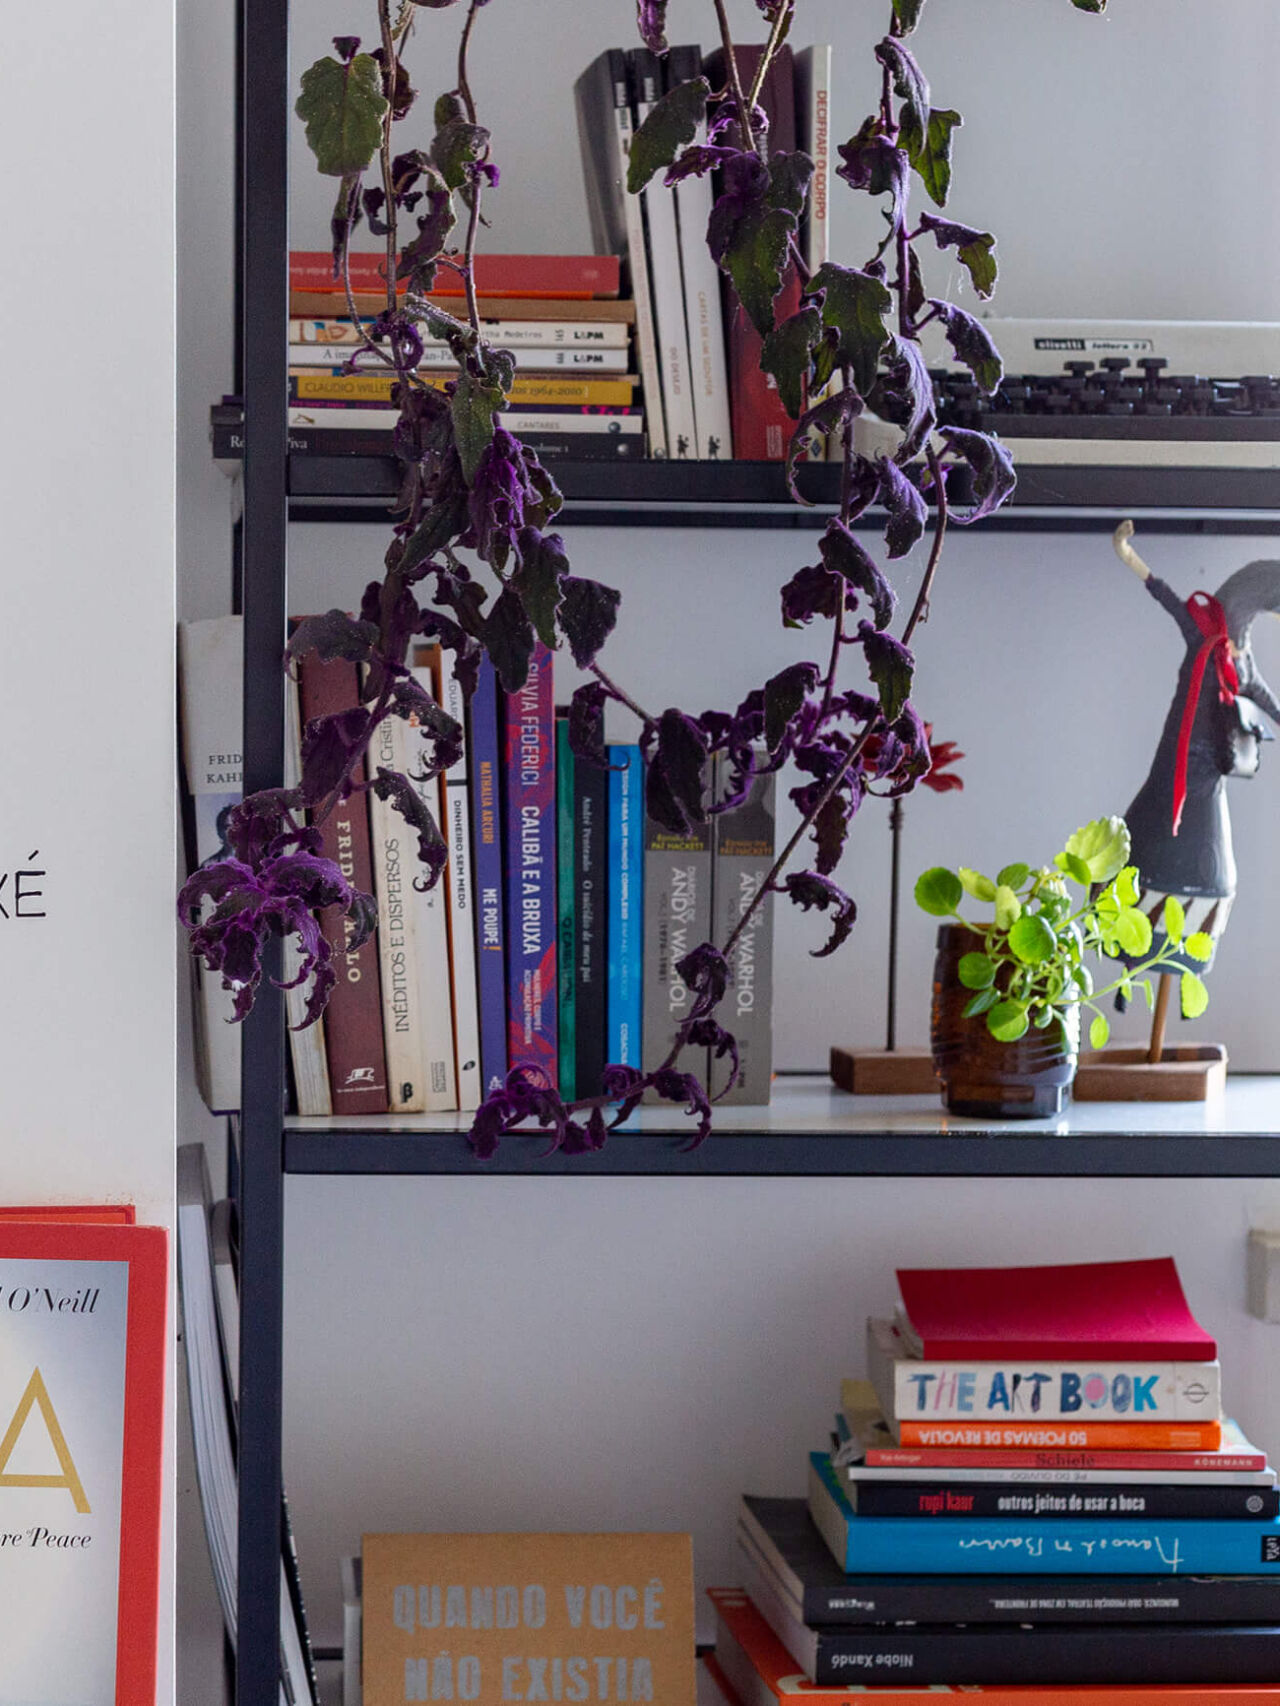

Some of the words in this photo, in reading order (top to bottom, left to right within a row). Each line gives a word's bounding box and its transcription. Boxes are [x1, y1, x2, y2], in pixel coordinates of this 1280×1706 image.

[816, 90, 827, 155] DECIFRAR
[816, 159, 827, 168] O
[815, 173, 826, 220] CORPO
[304, 382, 354, 393] CLAUDIO
[449, 679, 458, 721] EDUARD
[380, 716, 393, 762] Cristin
[521, 716, 539, 786] FEDERICI
[207, 754, 243, 765] FRID
[454, 800, 463, 851] DINHEIRO
[521, 805, 543, 866] CALIBÃ
[336, 820, 355, 887] FRID
[456, 854, 465, 875] SEM
[385, 838, 405, 932] DISPERSOS
[522, 869, 540, 880] E
[522, 882, 540, 895] A
[457, 876, 466, 909] MEDO
[483, 888, 497, 904] ME
[671, 867, 688, 923] ANDY
[522, 899, 541, 955] BRUXA
[391, 936, 405, 947] E
[669, 928, 688, 1012] WAHOL
[737, 933, 755, 1017] WARHOL
[389, 950, 410, 1033] INÉDITOS
[8, 1286, 101, 1314] O'Neill
[907, 1371, 977, 1412] THE
[987, 1371, 1053, 1413] ART
[1060, 1371, 1160, 1413] BOOK
[919, 1430, 981, 1445] REVOLTA
[984, 1430, 1001, 1445] DE
[1004, 1430, 1066, 1446] POEMAS
[1068, 1431, 1087, 1446] 50
[1036, 1452, 1095, 1467] Schiele
[918, 1491, 944, 1515] rupi
[946, 1490, 975, 1511] kaur
[997, 1495, 1033, 1511] outros
[1033, 1493, 1067, 1514] jeitos
[1068, 1494, 1083, 1511] de
[1084, 1497, 1108, 1511] usar
[1110, 1498, 1118, 1511] a
[1119, 1494, 1146, 1511] boca
[29, 1527, 92, 1548] Peace
[393, 1584, 547, 1635] QUANDO
[564, 1577, 666, 1631] VOCÊ
[831, 1654, 873, 1669] Xandó
[875, 1654, 914, 1667] Niobe
[404, 1650, 481, 1701] NÃO
[502, 1656, 655, 1702] EXISTIA
